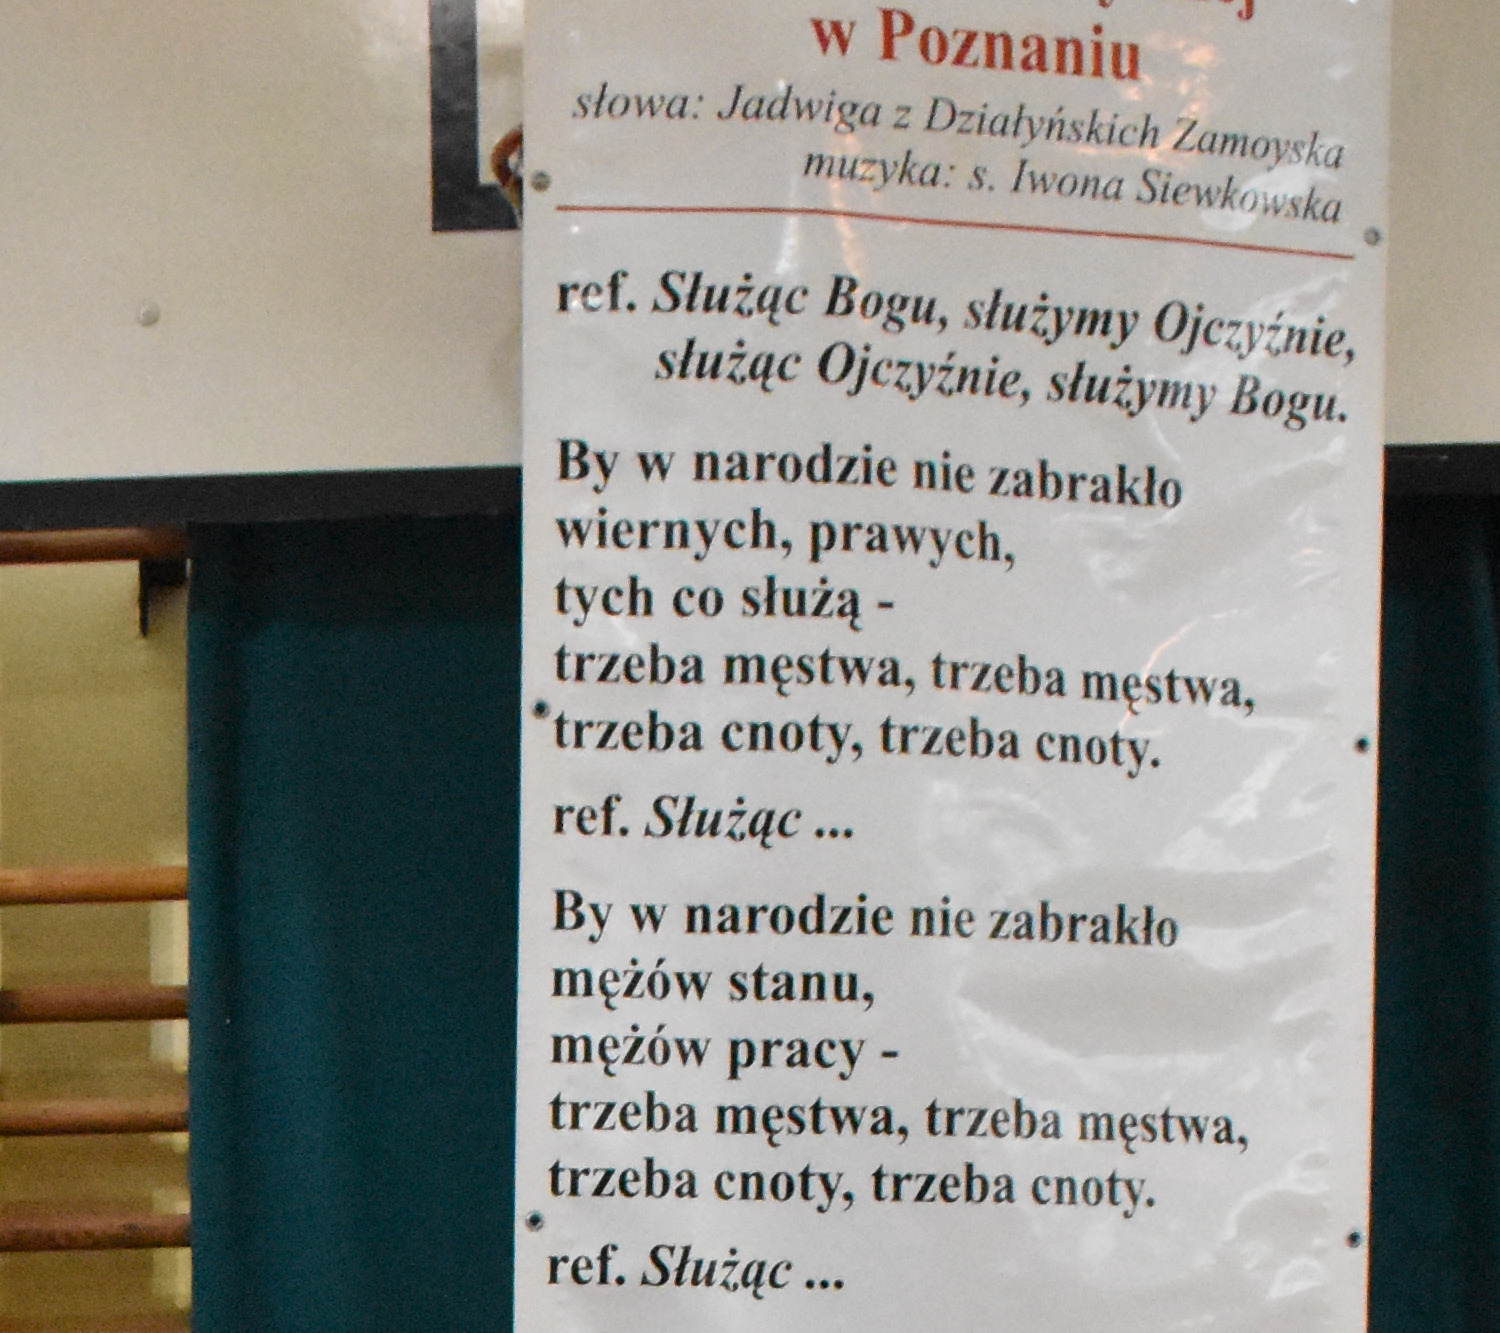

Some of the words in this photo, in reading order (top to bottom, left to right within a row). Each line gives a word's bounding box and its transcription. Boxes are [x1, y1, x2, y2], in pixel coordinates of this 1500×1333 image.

[810, 17, 856, 57] w
[879, 7, 1141, 81] Poznaniu
[572, 81, 704, 120] słowa:
[716, 84, 882, 134] Jadwiga
[892, 105, 912, 130] z
[924, 97, 1160, 150] Działyńskich
[1171, 119, 1344, 170] Zamoyska
[803, 149, 956, 193] muzyka:
[968, 166, 994, 191] s.
[1011, 158, 1124, 202] Iwona
[1135, 168, 1342, 225] Siewkowska
[556, 268, 637, 314] ref.
[650, 269, 810, 328] Służąc
[823, 273, 948, 334] Bogu,
[963, 287, 1140, 352] służymy
[1153, 300, 1356, 366] Ojczyźnie,
[654, 336, 802, 395] służąc
[816, 341, 1032, 408] Ojczyźnie,
[1045, 360, 1217, 425] służymy
[1228, 373, 1348, 432] Bogu.
[557, 437, 620, 496] By
[635, 450, 676, 483] w
[692, 441, 898, 489] narodzie
[913, 449, 976, 495] nie
[988, 457, 1183, 509] zabrakło
[554, 505, 793, 563] wiernych,
[808, 519, 1016, 572] prawych,
[554, 573, 654, 629] tych
[671, 585, 725, 619] co
[740, 573, 863, 634] służą
[553, 641, 705, 686] trzeba
[723, 647, 917, 699] męstwa,
[930, 651, 1067, 699] trzeba
[1081, 668, 1257, 717] męstwa,
[553, 709, 705, 753] trzeba
[720, 713, 864, 766] cnoty,
[879, 715, 1021, 761] trzeba
[1034, 730, 1161, 776] cnoty.
[553, 792, 630, 838] ref.
[643, 793, 803, 851] Służąc
[552, 888, 613, 945] By
[629, 902, 669, 934] w
[684, 892, 895, 937] narodzie
[909, 894, 976, 939] nie
[987, 899, 1180, 947] zabrakło
[550, 956, 713, 1012] mężów
[728, 962, 875, 1012] stanu,
[550, 1022, 712, 1079] mężów
[726, 1037, 866, 1082] pracy
[548, 1089, 699, 1134] trzeba
[714, 1096, 910, 1149] męstwa,
[924, 1097, 1063, 1140] trzeba
[1077, 1106, 1249, 1156] męstwa,
[547, 1156, 699, 1200] trzeba
[713, 1163, 856, 1215] cnoty,
[870, 1161, 1016, 1205] trzeba
[1030, 1169, 1156, 1220] cnoty.
[547, 1242, 627, 1287] ref.
[639, 1243, 793, 1302] Służąc
